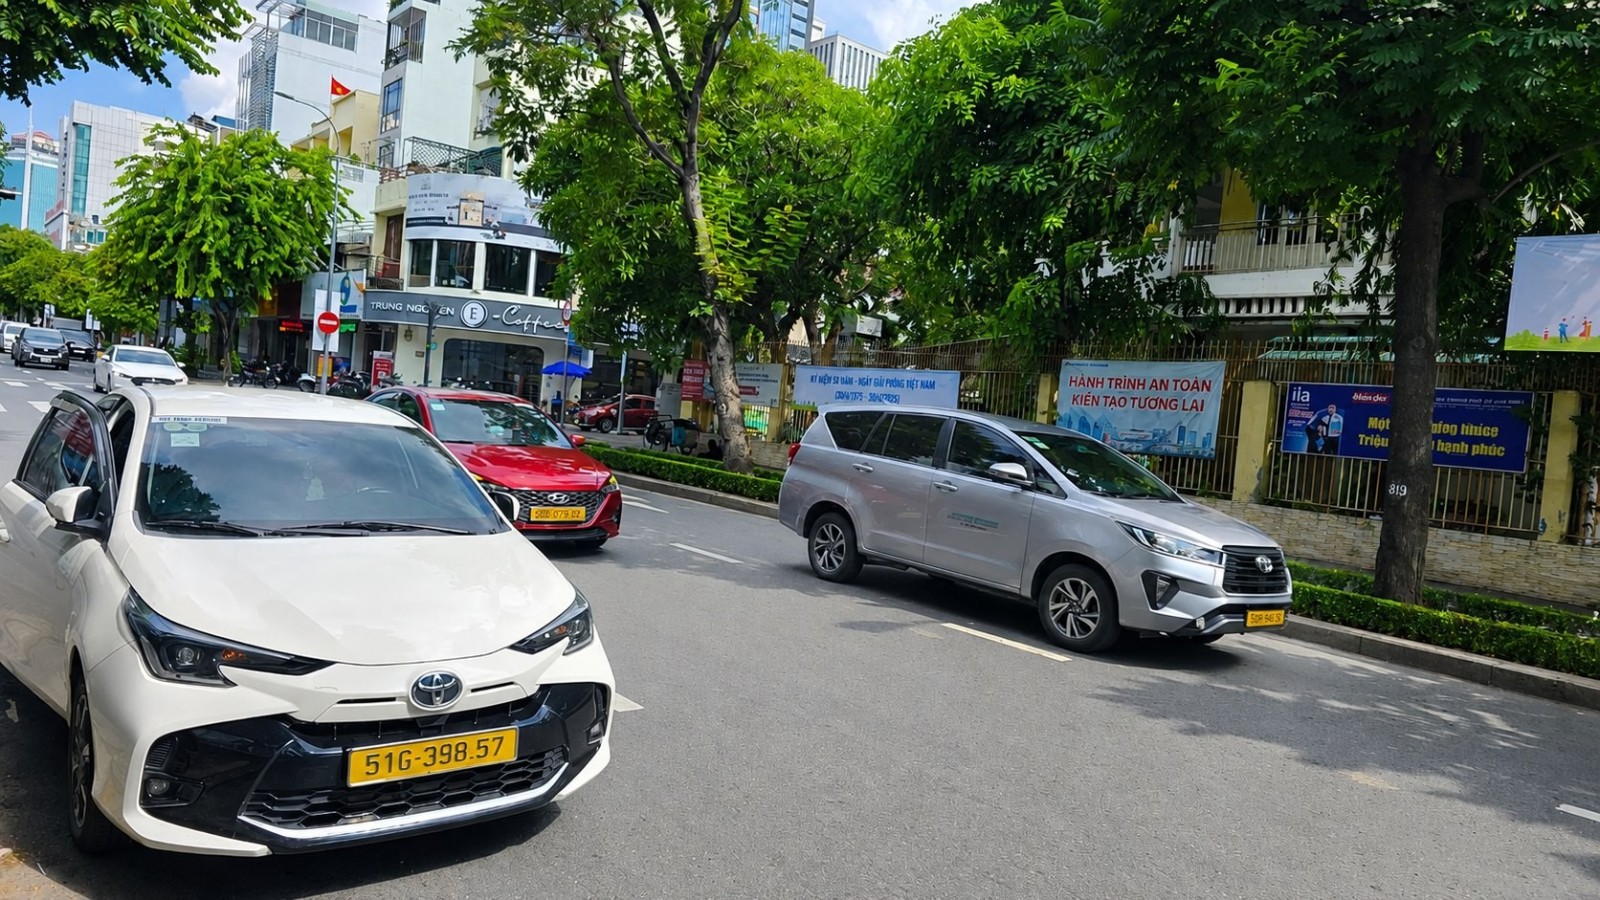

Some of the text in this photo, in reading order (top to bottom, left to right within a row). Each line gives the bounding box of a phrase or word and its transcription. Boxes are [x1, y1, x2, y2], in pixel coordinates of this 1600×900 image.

[370, 301, 403, 311] TRUNG
[1069, 373, 1212, 392] HÀNH TRÌNH AN TOÀN
[1103, 396, 1127, 410] TẠO
[1130, 396, 1179, 411] TƯƠNG
[1182, 398, 1205, 412] LAI
[1367, 417, 1391, 432] Một
[1358, 434, 1389, 448] Triệu
[1437, 439, 1469, 454] hạnh
[1471, 443, 1506, 457] phúc
[1388, 483, 1407, 496] 819
[365, 736, 505, 777] 51G-398.57
